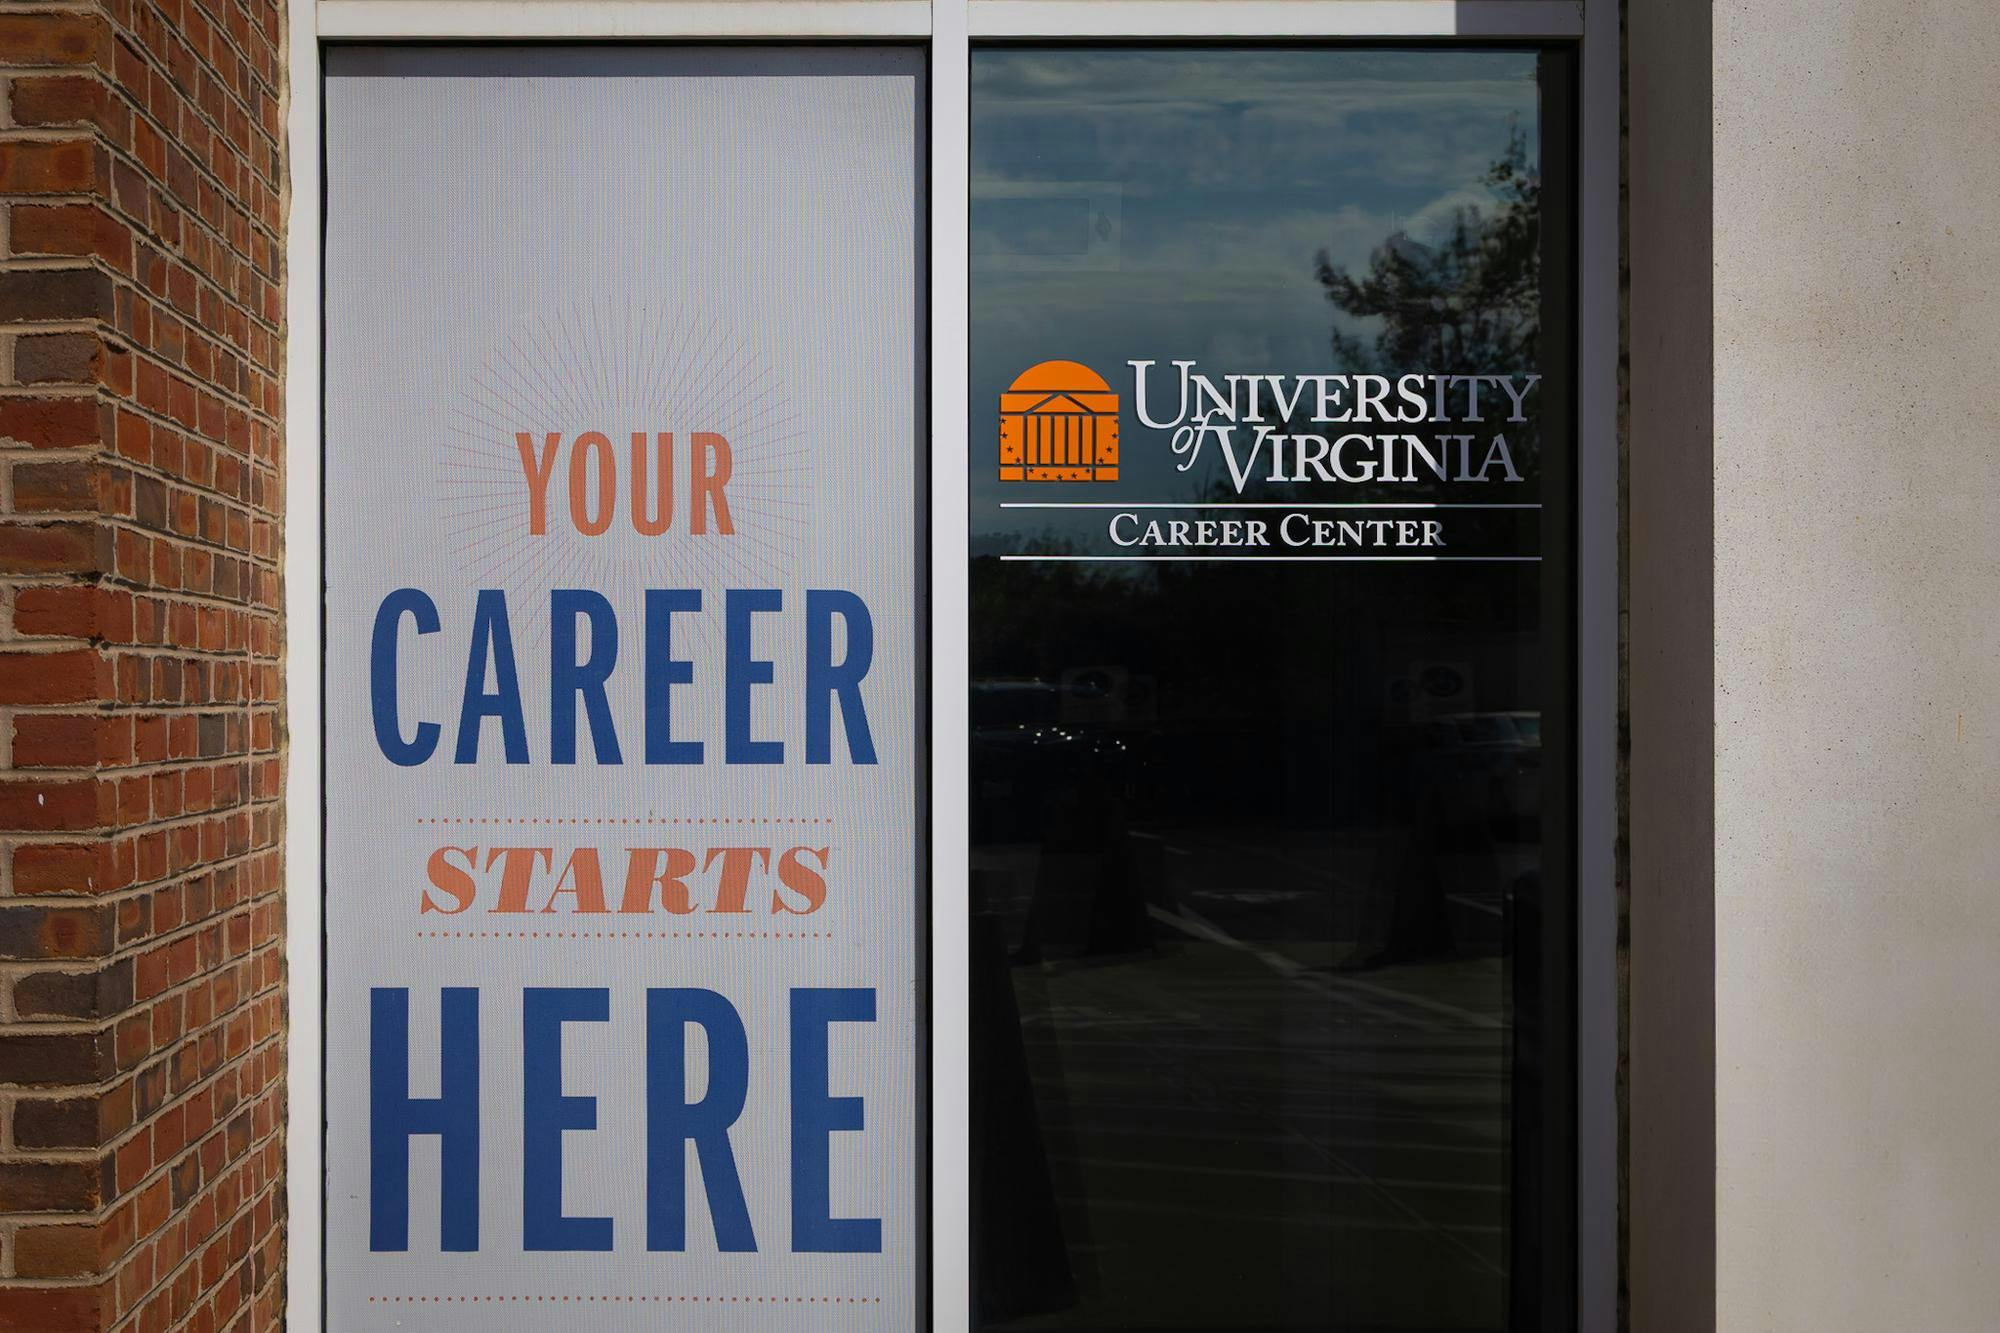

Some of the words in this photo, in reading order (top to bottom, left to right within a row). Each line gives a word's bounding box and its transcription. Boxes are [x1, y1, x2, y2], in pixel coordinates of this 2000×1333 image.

[1127, 360, 1542, 429] UNIVERSITY
[1171, 407, 1225, 472] of
[1194, 425, 1525, 495] VIRGINIA
[515, 431, 736, 537] YOUR
[1108, 513, 1271, 547] CAREER
[1279, 513, 1447, 547] CENTER
[370, 587, 880, 767] CAREER
[419, 845, 830, 917] STARTS
[370, 986, 882, 1254] HERE
